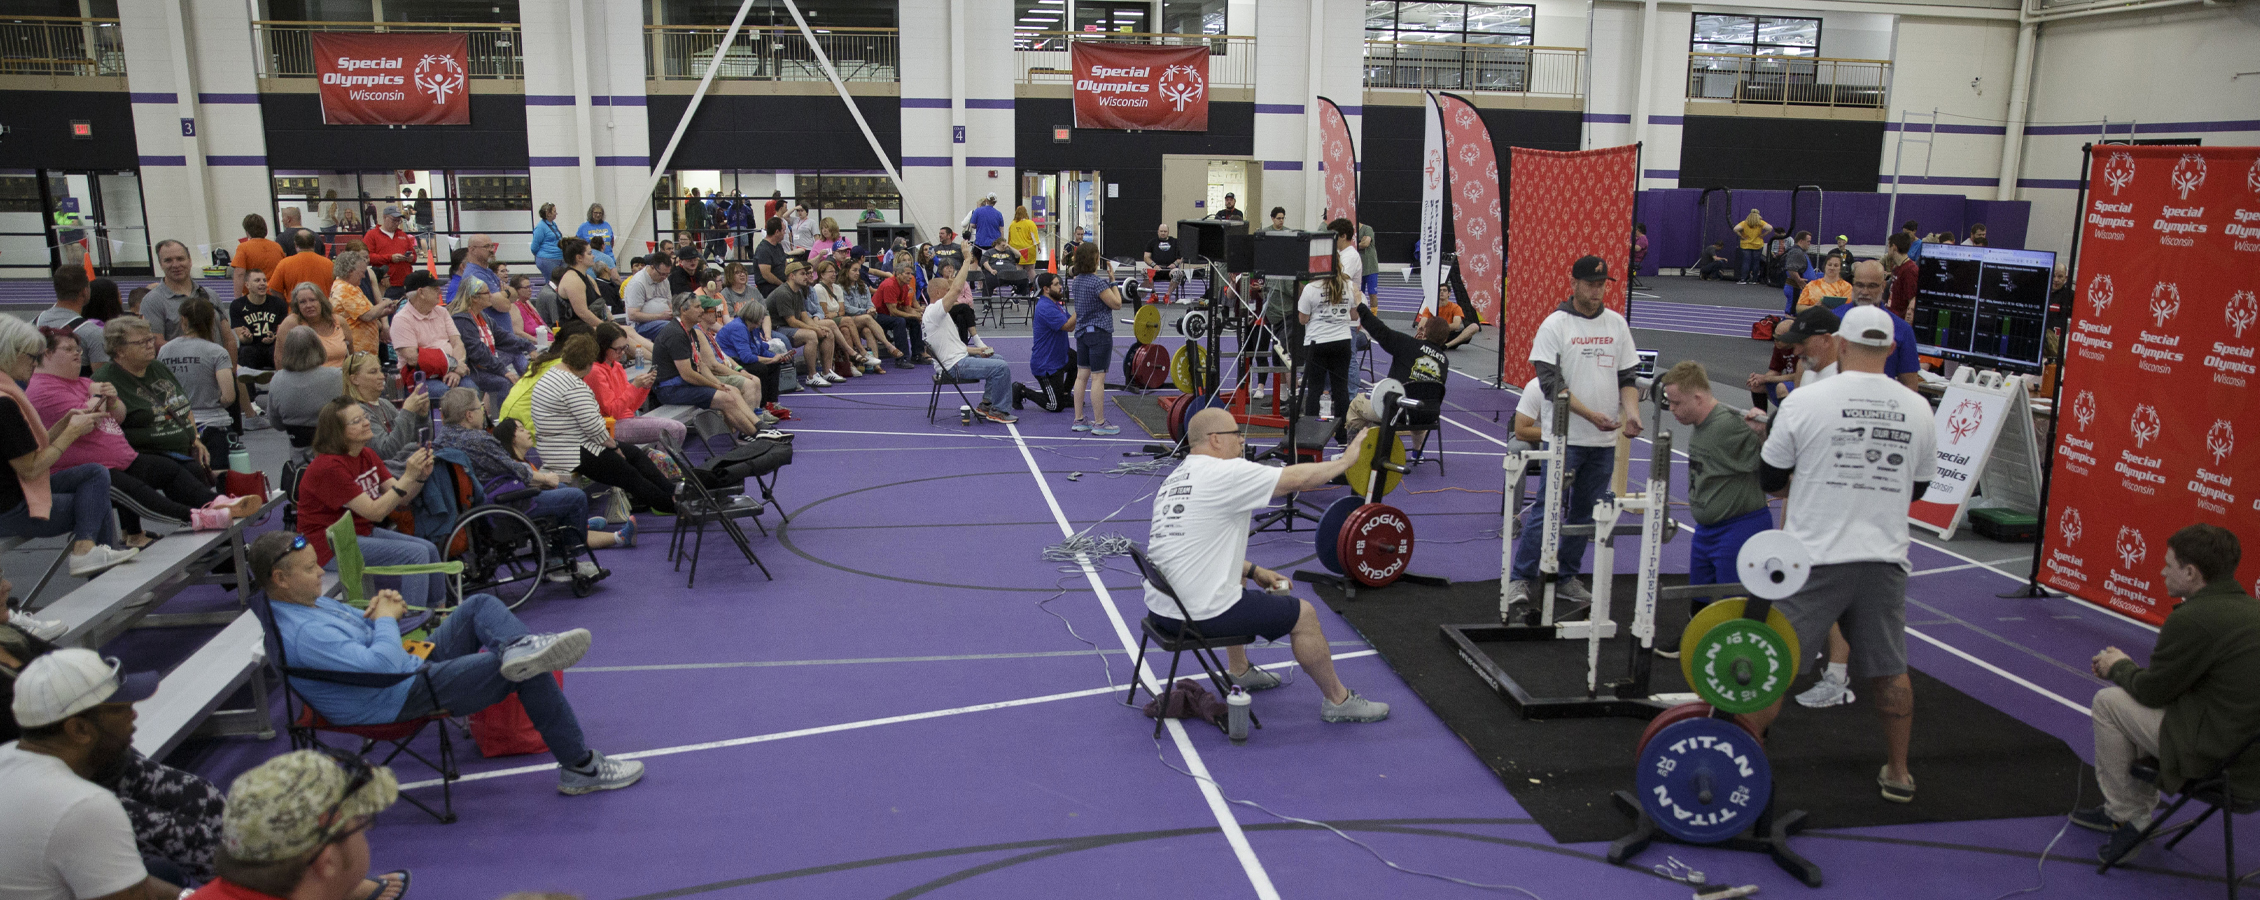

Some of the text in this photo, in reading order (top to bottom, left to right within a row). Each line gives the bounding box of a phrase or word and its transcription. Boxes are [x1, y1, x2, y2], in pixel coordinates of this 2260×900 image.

[338, 57, 403, 71] Special
[1091, 65, 1150, 79] Special
[323, 73, 404, 87] Olympics
[1076, 79, 1150, 94] Olympics
[349, 90, 405, 101] Wisconsin
[1099, 96, 1149, 108] Wisconsin
[184, 122, 193, 135] 3
[955, 130, 963, 141] 4
[2094, 200, 2133, 214] Special
[2162, 205, 2204, 218] Special
[2088, 213, 2135, 228] Olympics
[2094, 228, 2125, 241] Wisconsin
[243, 311, 276, 325] BUCKS
[252, 322, 269, 337] 34
[2078, 319, 2112, 335] Special
[1570, 336, 1614, 345] VOLUNTEER
[2071, 332, 2113, 350] Olympics
[2139, 330, 2180, 346] Special
[1419, 344, 1446, 364] ATHLETE
[2078, 347, 2105, 362] Wisconsin
[2131, 343, 2184, 362] Olympics
[2212, 341, 2255, 358] Special
[161, 356, 201, 365] ATHLETE
[2138, 359, 2171, 374] Wisconsin
[2203, 355, 2256, 374] Olympics
[2213, 372, 2246, 387] Wisconsin
[1844, 409, 1903, 422] VOLUNTEER
[1874, 428, 1911, 442] OUR TEAM
[2064, 433, 2094, 451] Special
[1936, 450, 1970, 466] pecial
[2058, 444, 2096, 466] Olympics
[2121, 449, 2162, 469] Special
[1936, 466, 1968, 482] mpics
[2114, 461, 2166, 484] Olympics
[2195, 467, 2232, 487] Special
[1177, 486, 1191, 495] TEAM
[2121, 477, 2155, 496] Wisconsin
[2187, 480, 2235, 503] Olympics
[1549, 460, 1561, 551] EQUIPMENT
[1360, 514, 1406, 536] ROGUE
[1356, 540, 1366, 549] 25
[1645, 509, 1660, 614] EQUIPMENT
[2053, 548, 2083, 567] Special
[1357, 558, 1403, 579] ROGUE
[2046, 558, 2087, 582] Olympics
[2048, 574, 2080, 591] Wisconsin
[2109, 568, 2150, 591] Special
[2103, 579, 2156, 606] Olympics
[2108, 595, 2147, 615] Wisconsin
[1747, 632, 1779, 692] TITAN
[1704, 642, 1737, 702] TITAN
[1656, 756, 1677, 772] 20
[1669, 735, 1754, 778] TITAN
[1656, 767, 1669, 778] KG
[1653, 784, 1737, 826] TITAN
[1729, 791, 1750, 807] 20
